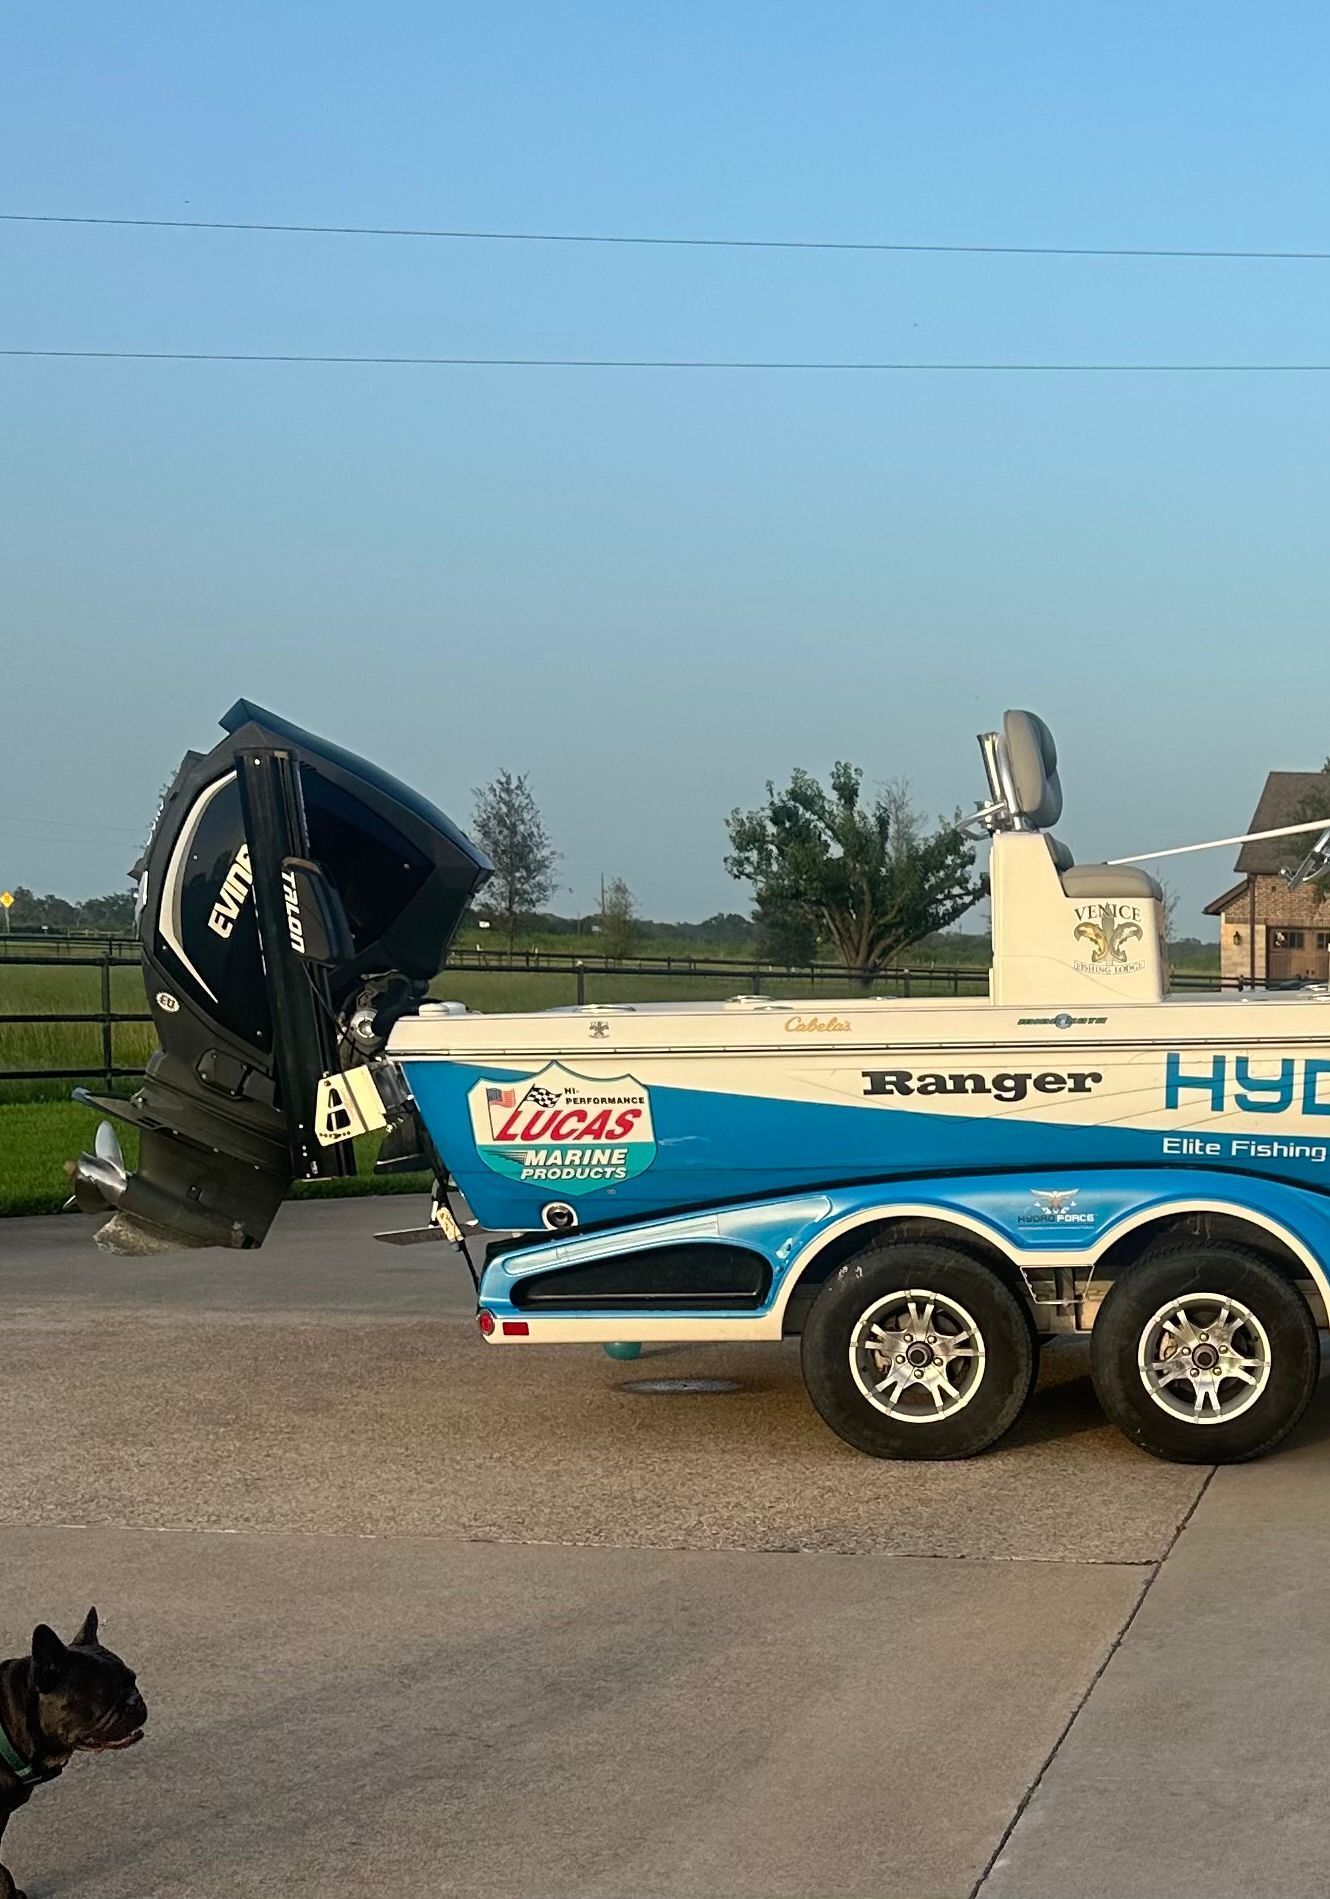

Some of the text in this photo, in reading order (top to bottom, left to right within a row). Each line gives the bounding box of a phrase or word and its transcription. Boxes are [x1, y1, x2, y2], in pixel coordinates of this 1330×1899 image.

[281, 871, 306, 954] TALON
[1074, 903, 1142, 922] VENICE
[861, 1070, 1103, 1103] Ranger
[565, 1096, 646, 1105] PERFORMANCE
[494, 1108, 643, 1142] LUCAS
[524, 1148, 628, 1167] MARINE
[1163, 1137, 1221, 1156] Elite
[1231, 1140, 1327, 1162] Fishing
[520, 1167, 627, 1181] PRODUCTS
[1017, 1213, 1095, 1223] HYDRO FORCE
